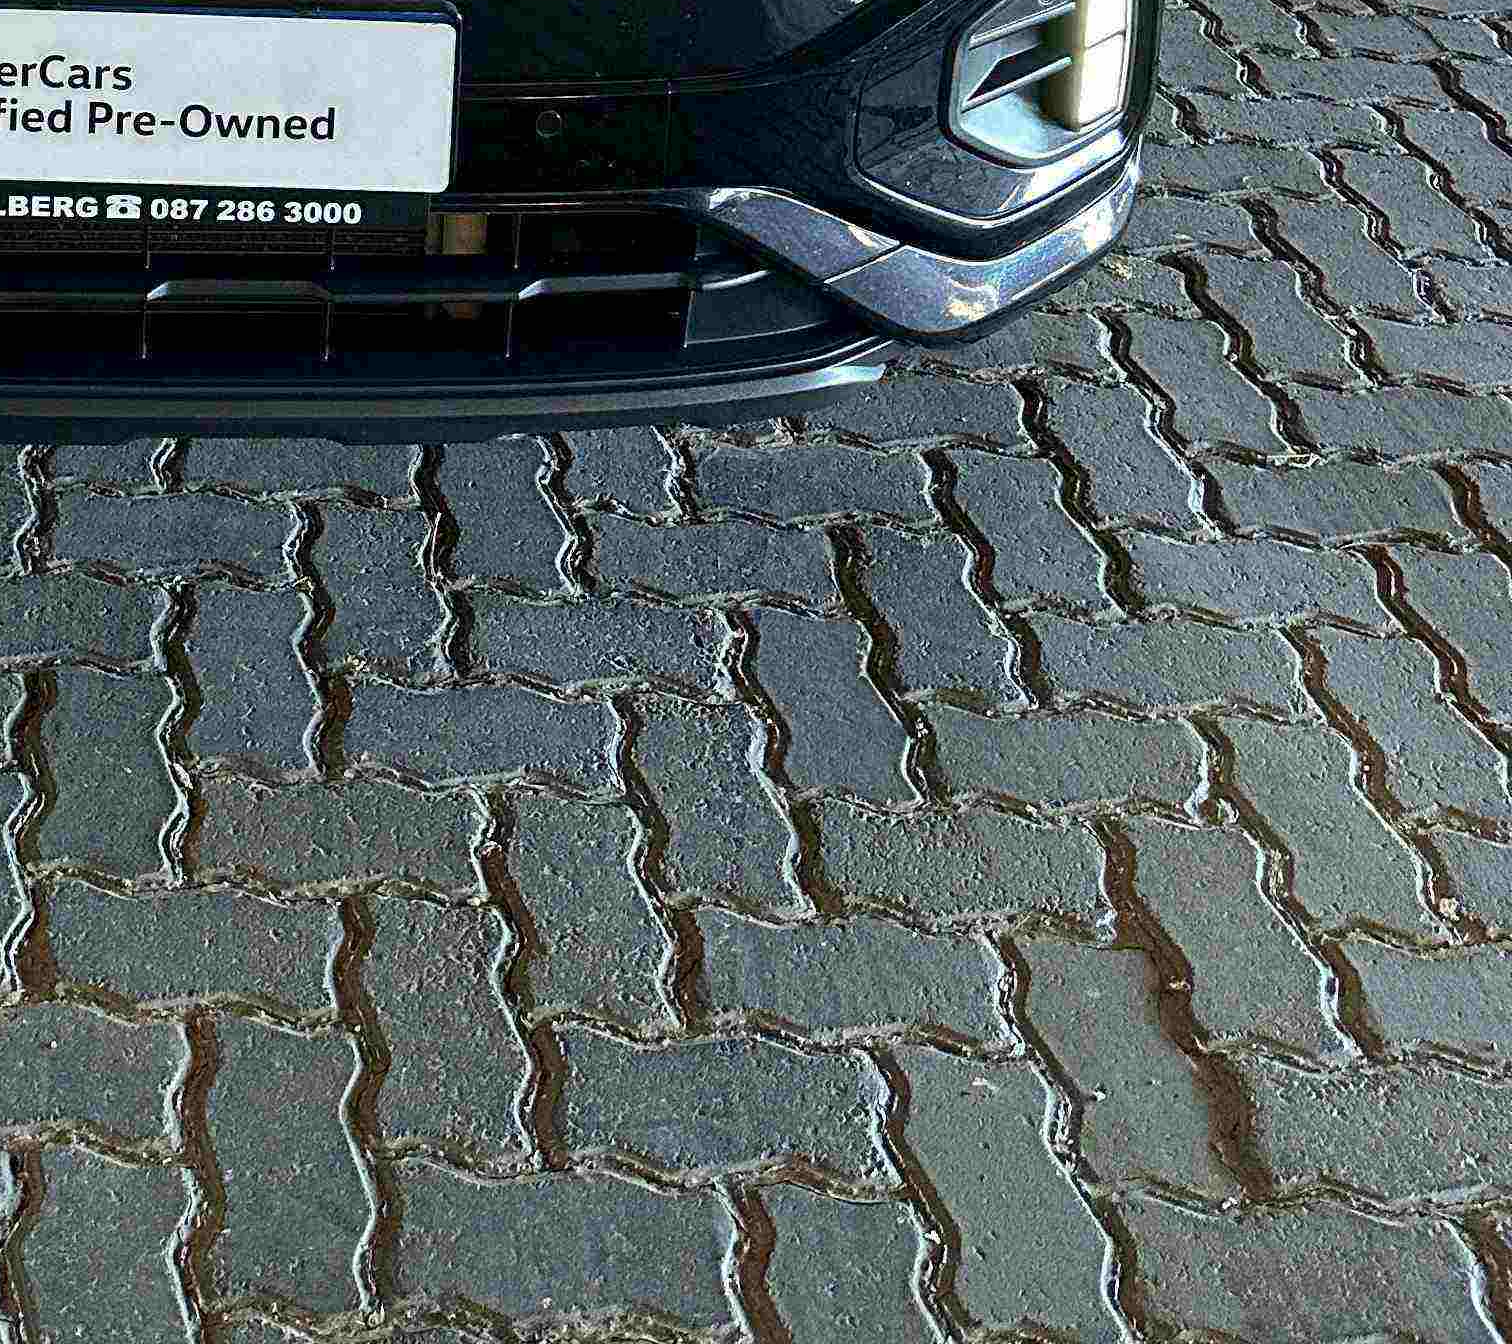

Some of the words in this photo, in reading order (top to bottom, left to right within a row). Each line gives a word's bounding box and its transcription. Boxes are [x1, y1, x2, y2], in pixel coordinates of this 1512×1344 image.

[87, 100, 336, 141] Pre-Owned
[149, 197, 209, 221] 087
[215, 199, 276, 222] 286
[283, 201, 363, 224] 3000
